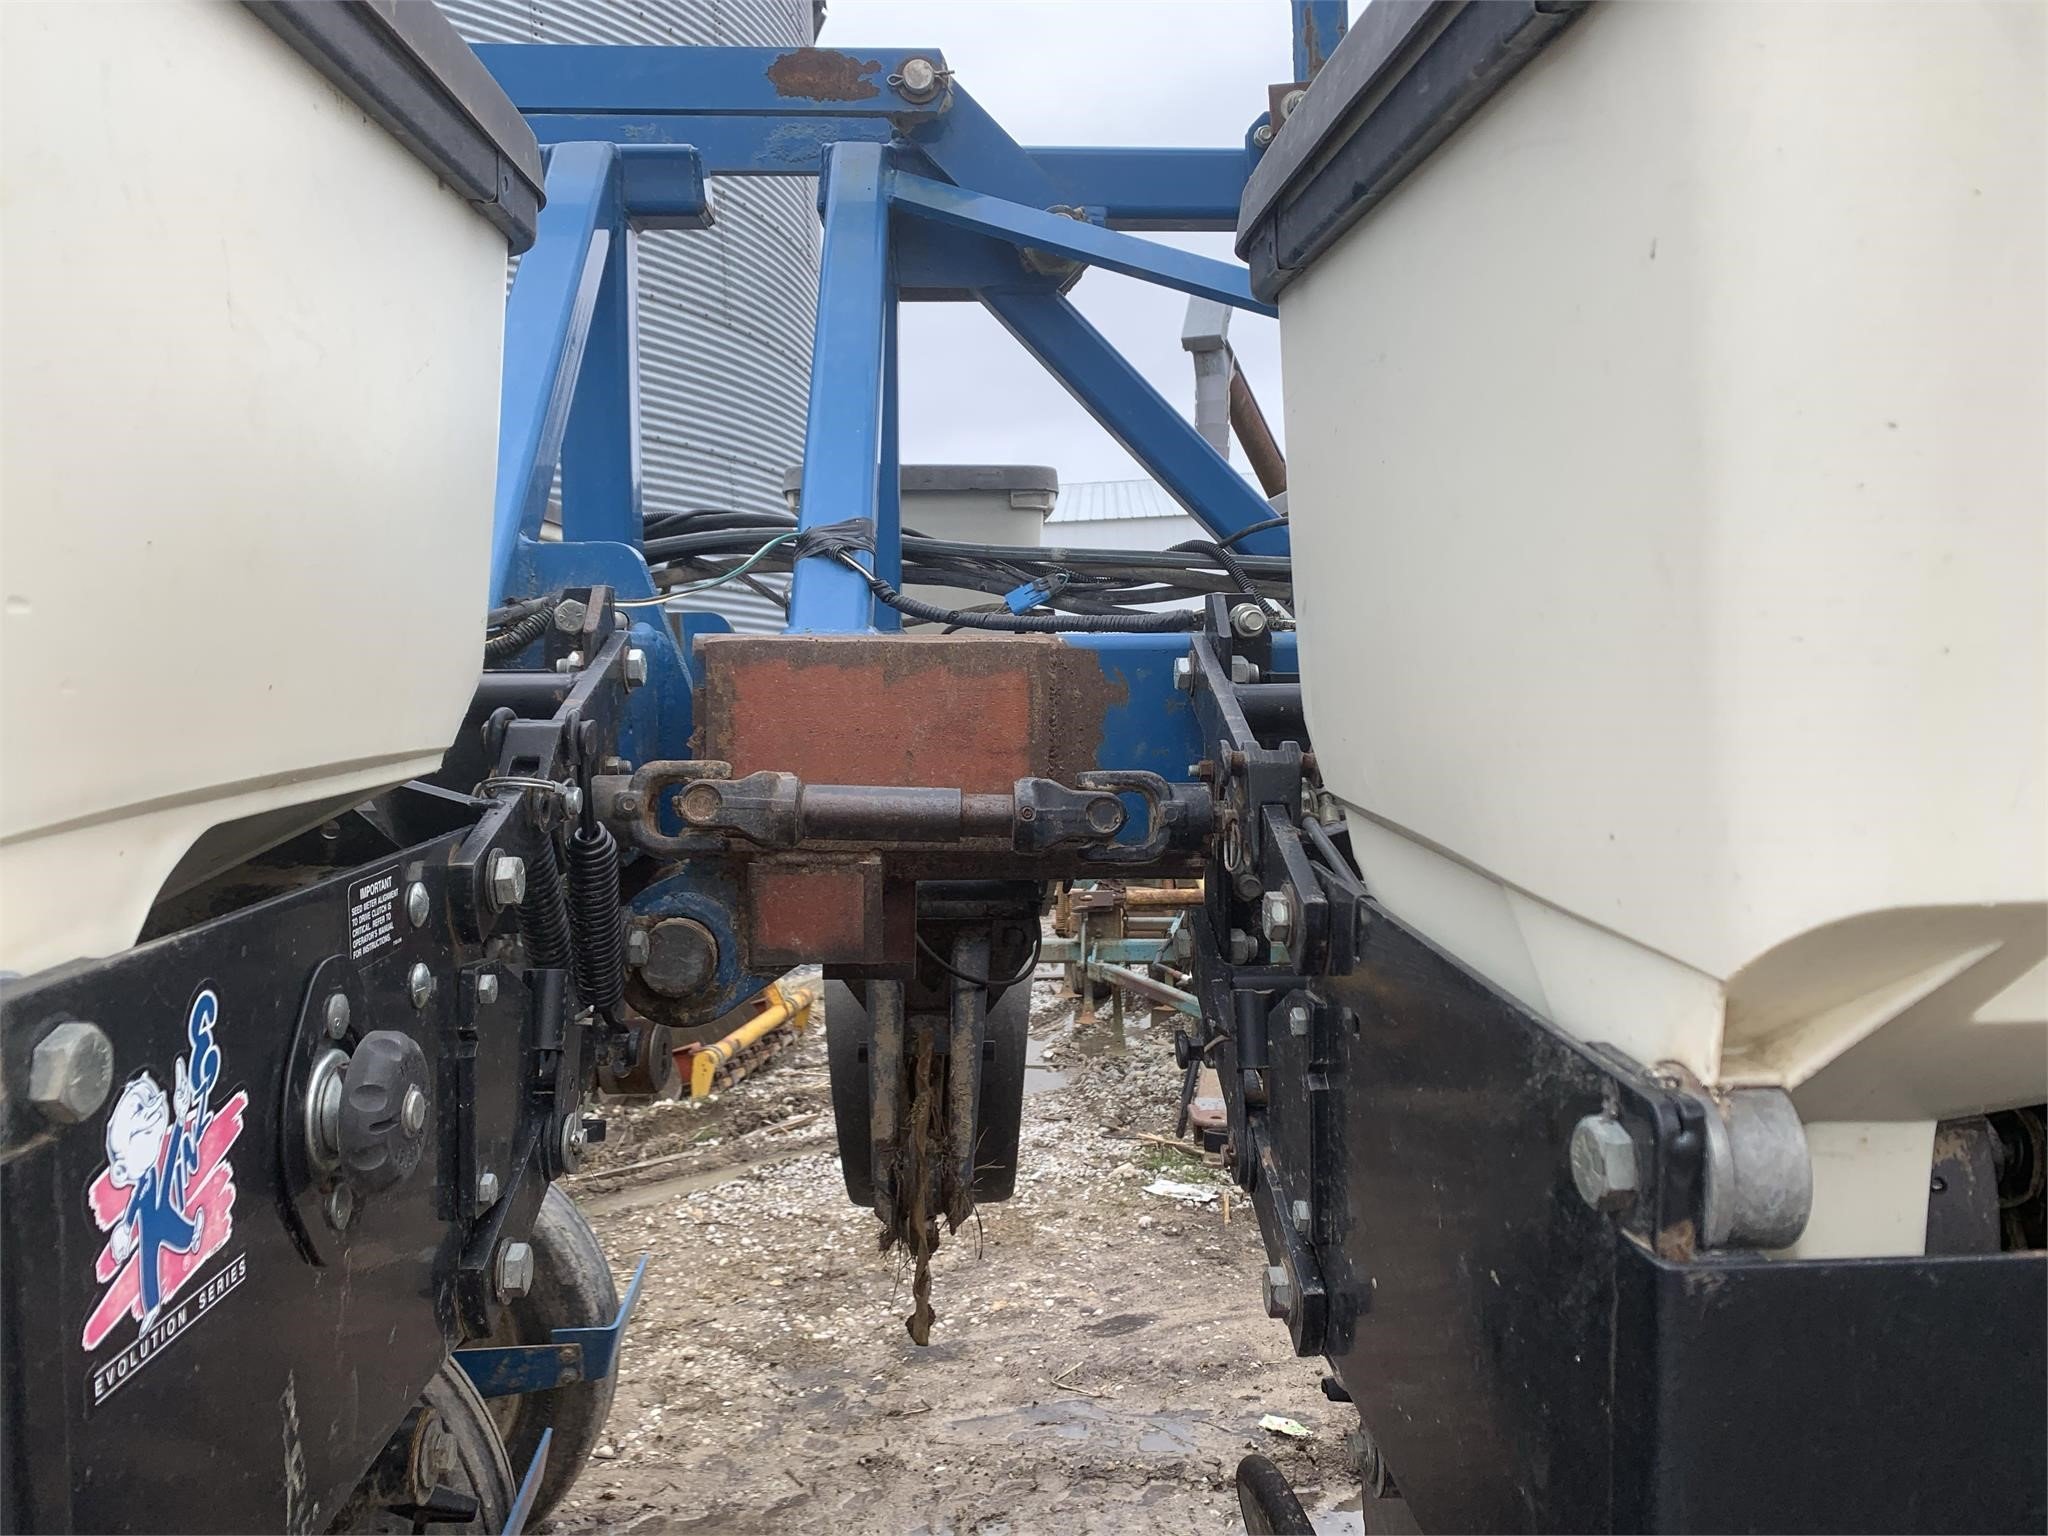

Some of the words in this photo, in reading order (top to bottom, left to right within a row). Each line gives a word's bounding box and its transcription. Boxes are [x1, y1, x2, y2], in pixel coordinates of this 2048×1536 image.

[360, 876, 392, 900] IMPORTANT
[352, 905, 363, 916] SEED
[363, 898, 377, 911] METER
[378, 888, 399, 904] ALIGNMENT
[352, 917, 359, 927] TO
[359, 911, 371, 924] DRIVE
[371, 905, 387, 917] CLUTCH
[387, 902, 392, 910] IS
[372, 915, 385, 928] REFER
[385, 912, 392, 921] TO
[352, 929, 378, 949] OPERATOR'S
[378, 921, 395, 936] MANUAL
[352, 948, 362, 959] FOR
[94, 1306, 188, 1398] EVOLUTION
[198, 1258, 246, 1310] SERIES
